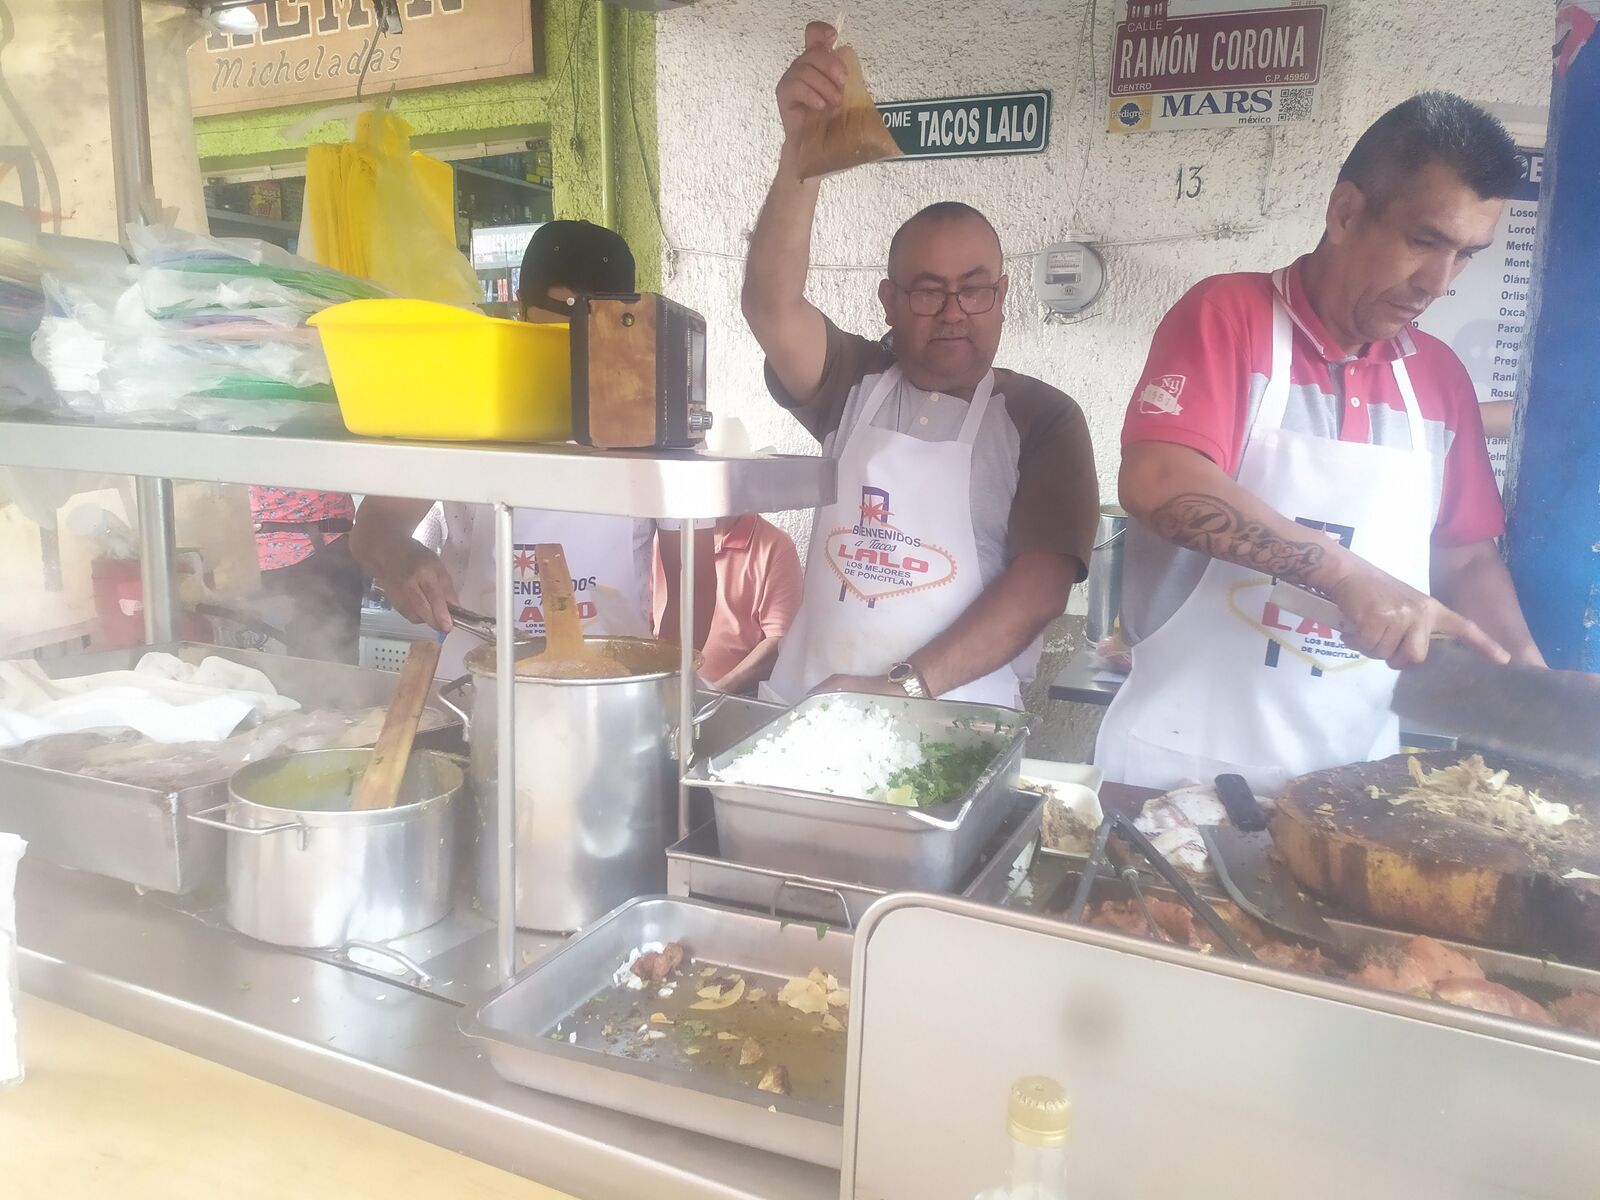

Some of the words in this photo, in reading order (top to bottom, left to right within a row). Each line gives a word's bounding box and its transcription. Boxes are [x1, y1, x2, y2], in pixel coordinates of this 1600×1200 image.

[1127, 20, 1163, 33] CALLE
[1119, 27, 1200, 79] RAMÓN
[1211, 25, 1305, 72] CORONA
[211, 38, 402, 92] Micheladas
[1265, 74, 1281, 83] C.P.
[1284, 72, 1310, 82] 45950
[1117, 83, 1152, 92] CENTRO
[1160, 89, 1273, 118] MARS
[882, 110, 912, 128] OME
[918, 107, 980, 147] TACOS
[985, 103, 1038, 144] LALO
[1238, 116, 1271, 124] méxico
[1175, 163, 1204, 200] 13
[1506, 241, 1534, 251] Metfo
[1504, 257, 1530, 268] Mont
[1501, 291, 1528, 300] Orlist
[1499, 307, 1526, 317] Oxca
[1497, 323, 1523, 333] Paro
[1495, 340, 1521, 351] Prog
[1494, 356, 1519, 368] Preg
[1492, 372, 1517, 381] Rani
[1491, 388, 1515, 398] Rosu
[852, 525, 921, 548] BIENVENIDOS
[869, 539, 897, 552] Tacos
[838, 543, 929, 574] LALO
[846, 560, 863, 570] LOS
[864, 564, 912, 578] MEJORES
[844, 568, 856, 576] DE
[857, 571, 913, 587] PONCITLÁN
[1262, 602, 1333, 639] LA
[1305, 637, 1321, 645] LOS
[1324, 641, 1345, 649] MEJO
[1301, 646, 1313, 654] DE
